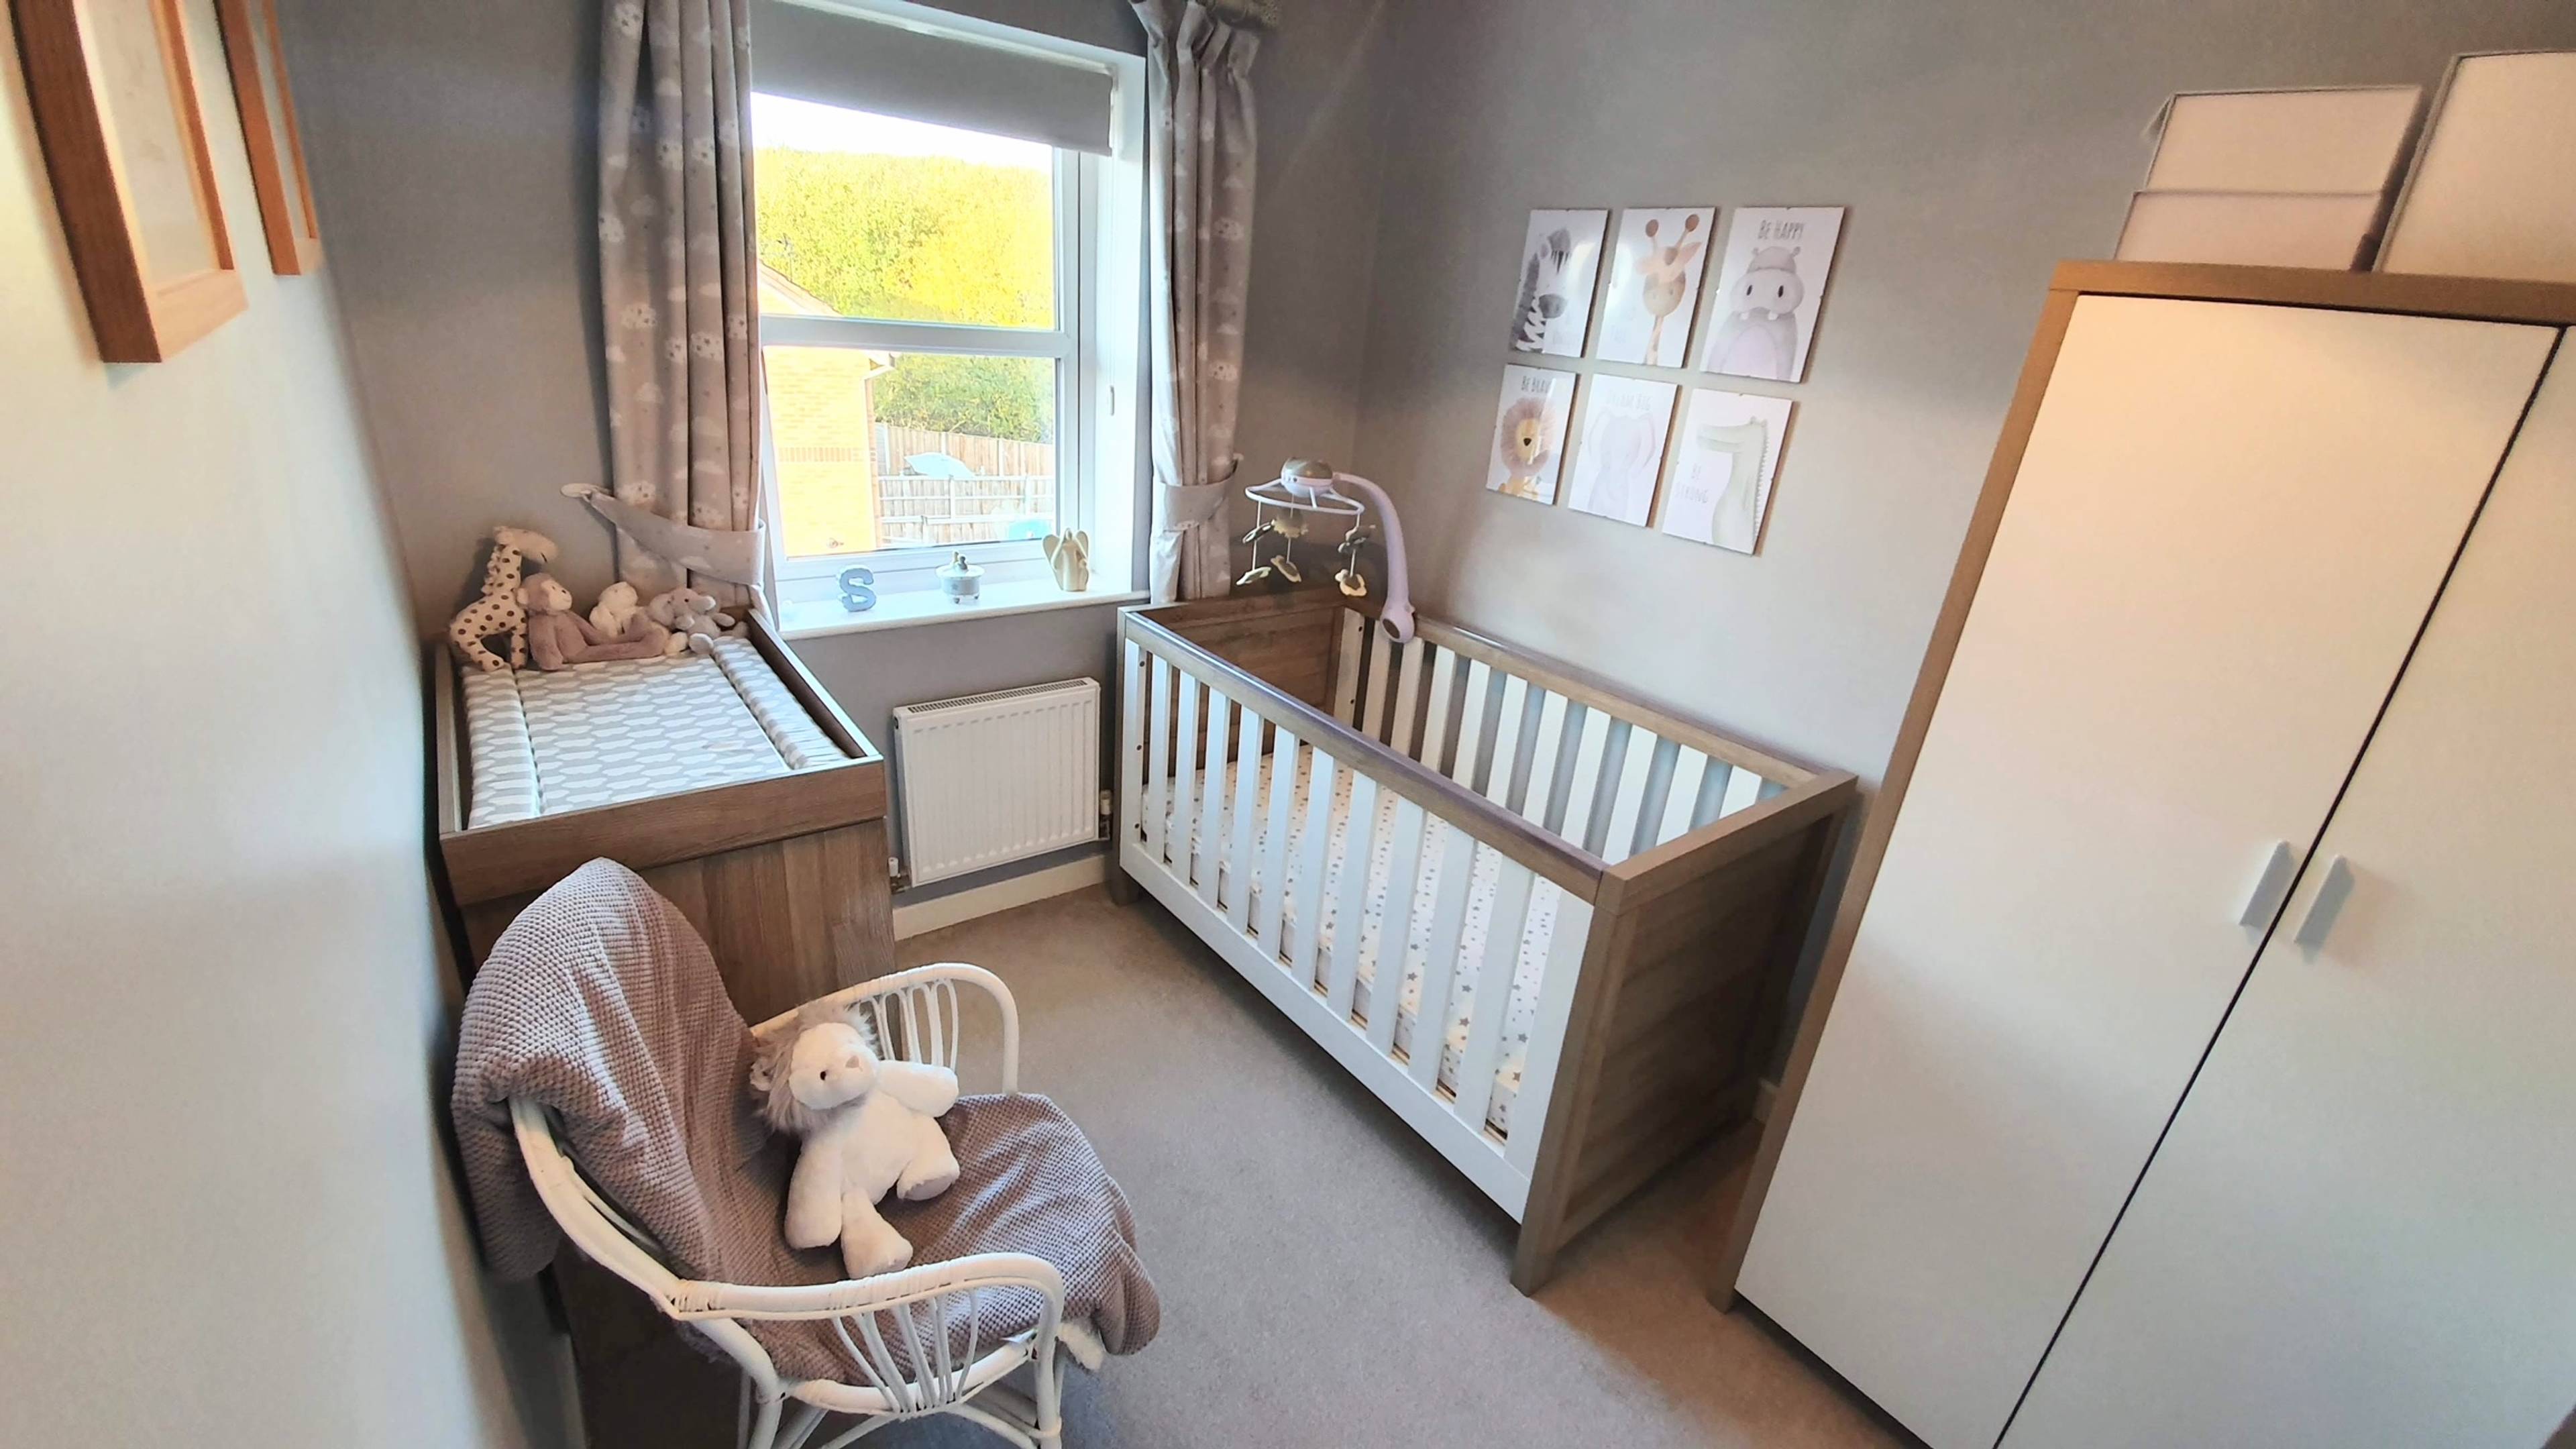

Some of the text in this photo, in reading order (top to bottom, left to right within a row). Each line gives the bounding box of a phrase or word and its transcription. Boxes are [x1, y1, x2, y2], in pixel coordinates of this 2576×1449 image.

[1758, 219, 1806, 239] BE HAPPY
[1521, 376, 1531, 392] BE
[838, 564, 876, 612] S
